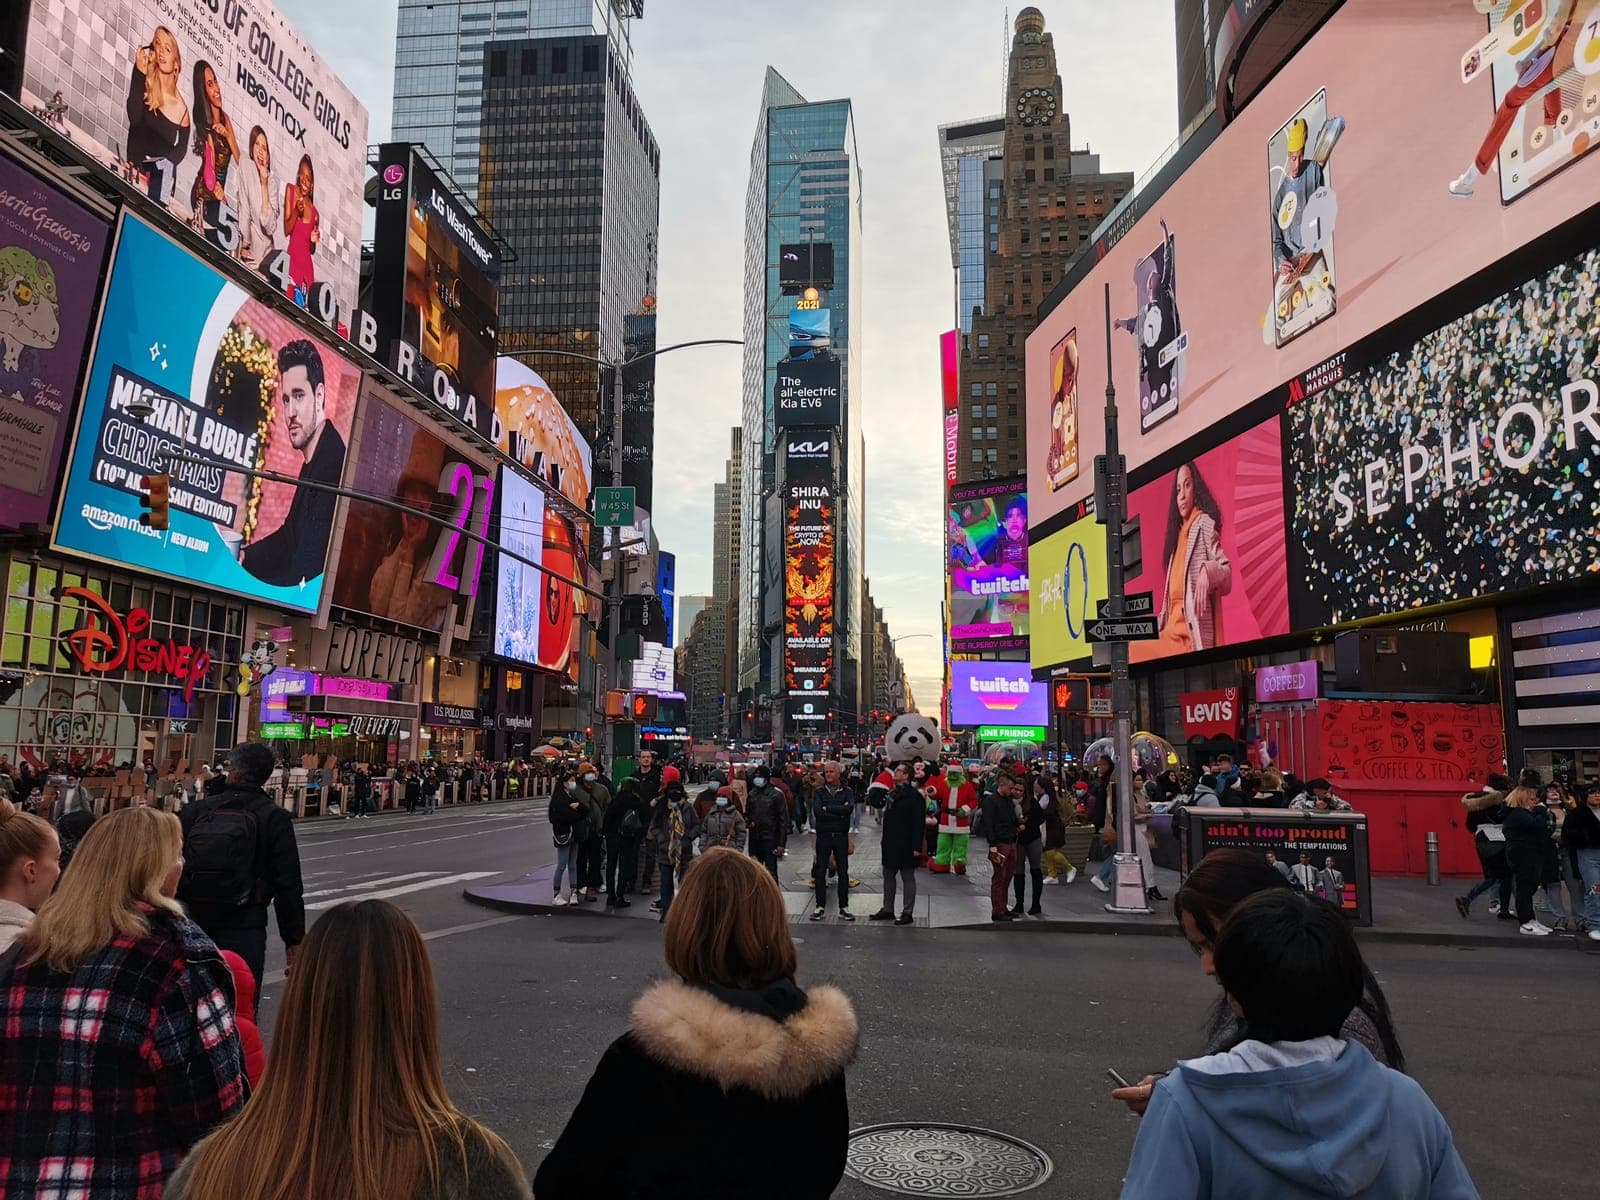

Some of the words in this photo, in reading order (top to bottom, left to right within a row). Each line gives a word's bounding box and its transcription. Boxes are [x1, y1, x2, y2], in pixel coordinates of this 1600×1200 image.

[177, 2, 199, 27] NEW
[199, 23, 224, 55] SERIES
[177, 17, 224, 67] STREAMING
[223, 0, 248, 37] OF
[248, 21, 313, 111] COLLEGE
[313, 90, 351, 150] GIRLS
[383, 189, 402, 200] LG
[431, 188, 445, 216] LG
[797, 299, 820, 310] 2021
[1306, 353, 1346, 382] MARRIOTT
[780, 376, 801, 387] The
[1306, 367, 1342, 393] MARQUIS
[780, 386, 837, 398] all-electric
[780, 398, 798, 409] Kia
[800, 398, 822, 408] EV6
[200, 416, 258, 468] BUBLÉ
[610, 491, 621, 500] TO
[791, 486, 830, 497] SHIRA
[600, 503, 608, 511] W
[608, 502, 620, 510] 45
[621, 502, 630, 510] St
[799, 499, 821, 509] INU
[81, 503, 130, 533] amazon
[193, 500, 234, 525] EDITION)
[170, 530, 187, 546] NEW
[800, 538, 820, 546] NOW
[971, 575, 1030, 595] twitch
[1128, 599, 1147, 609] WAY
[1096, 625, 1116, 636] ONE
[1126, 624, 1148, 634] WAY
[326, 622, 424, 684] FOREVER
[970, 676, 1030, 693] twitch
[1263, 673, 1306, 693] COFFEED
[444, 706, 460, 718] POLO
[980, 728, 998, 737] LINE
[1000, 728, 1035, 737] FRIENDS
[1371, 762, 1409, 780] COFFEE
[1415, 762, 1426, 780] &
[1431, 763, 1453, 780] TEA
[1207, 823, 1249, 837] ain't
[1255, 825, 1287, 838] too
[1287, 825, 1347, 842] proud
[1284, 841, 1298, 849] THE
[1299, 842, 1348, 851] TEMPTATIONS
